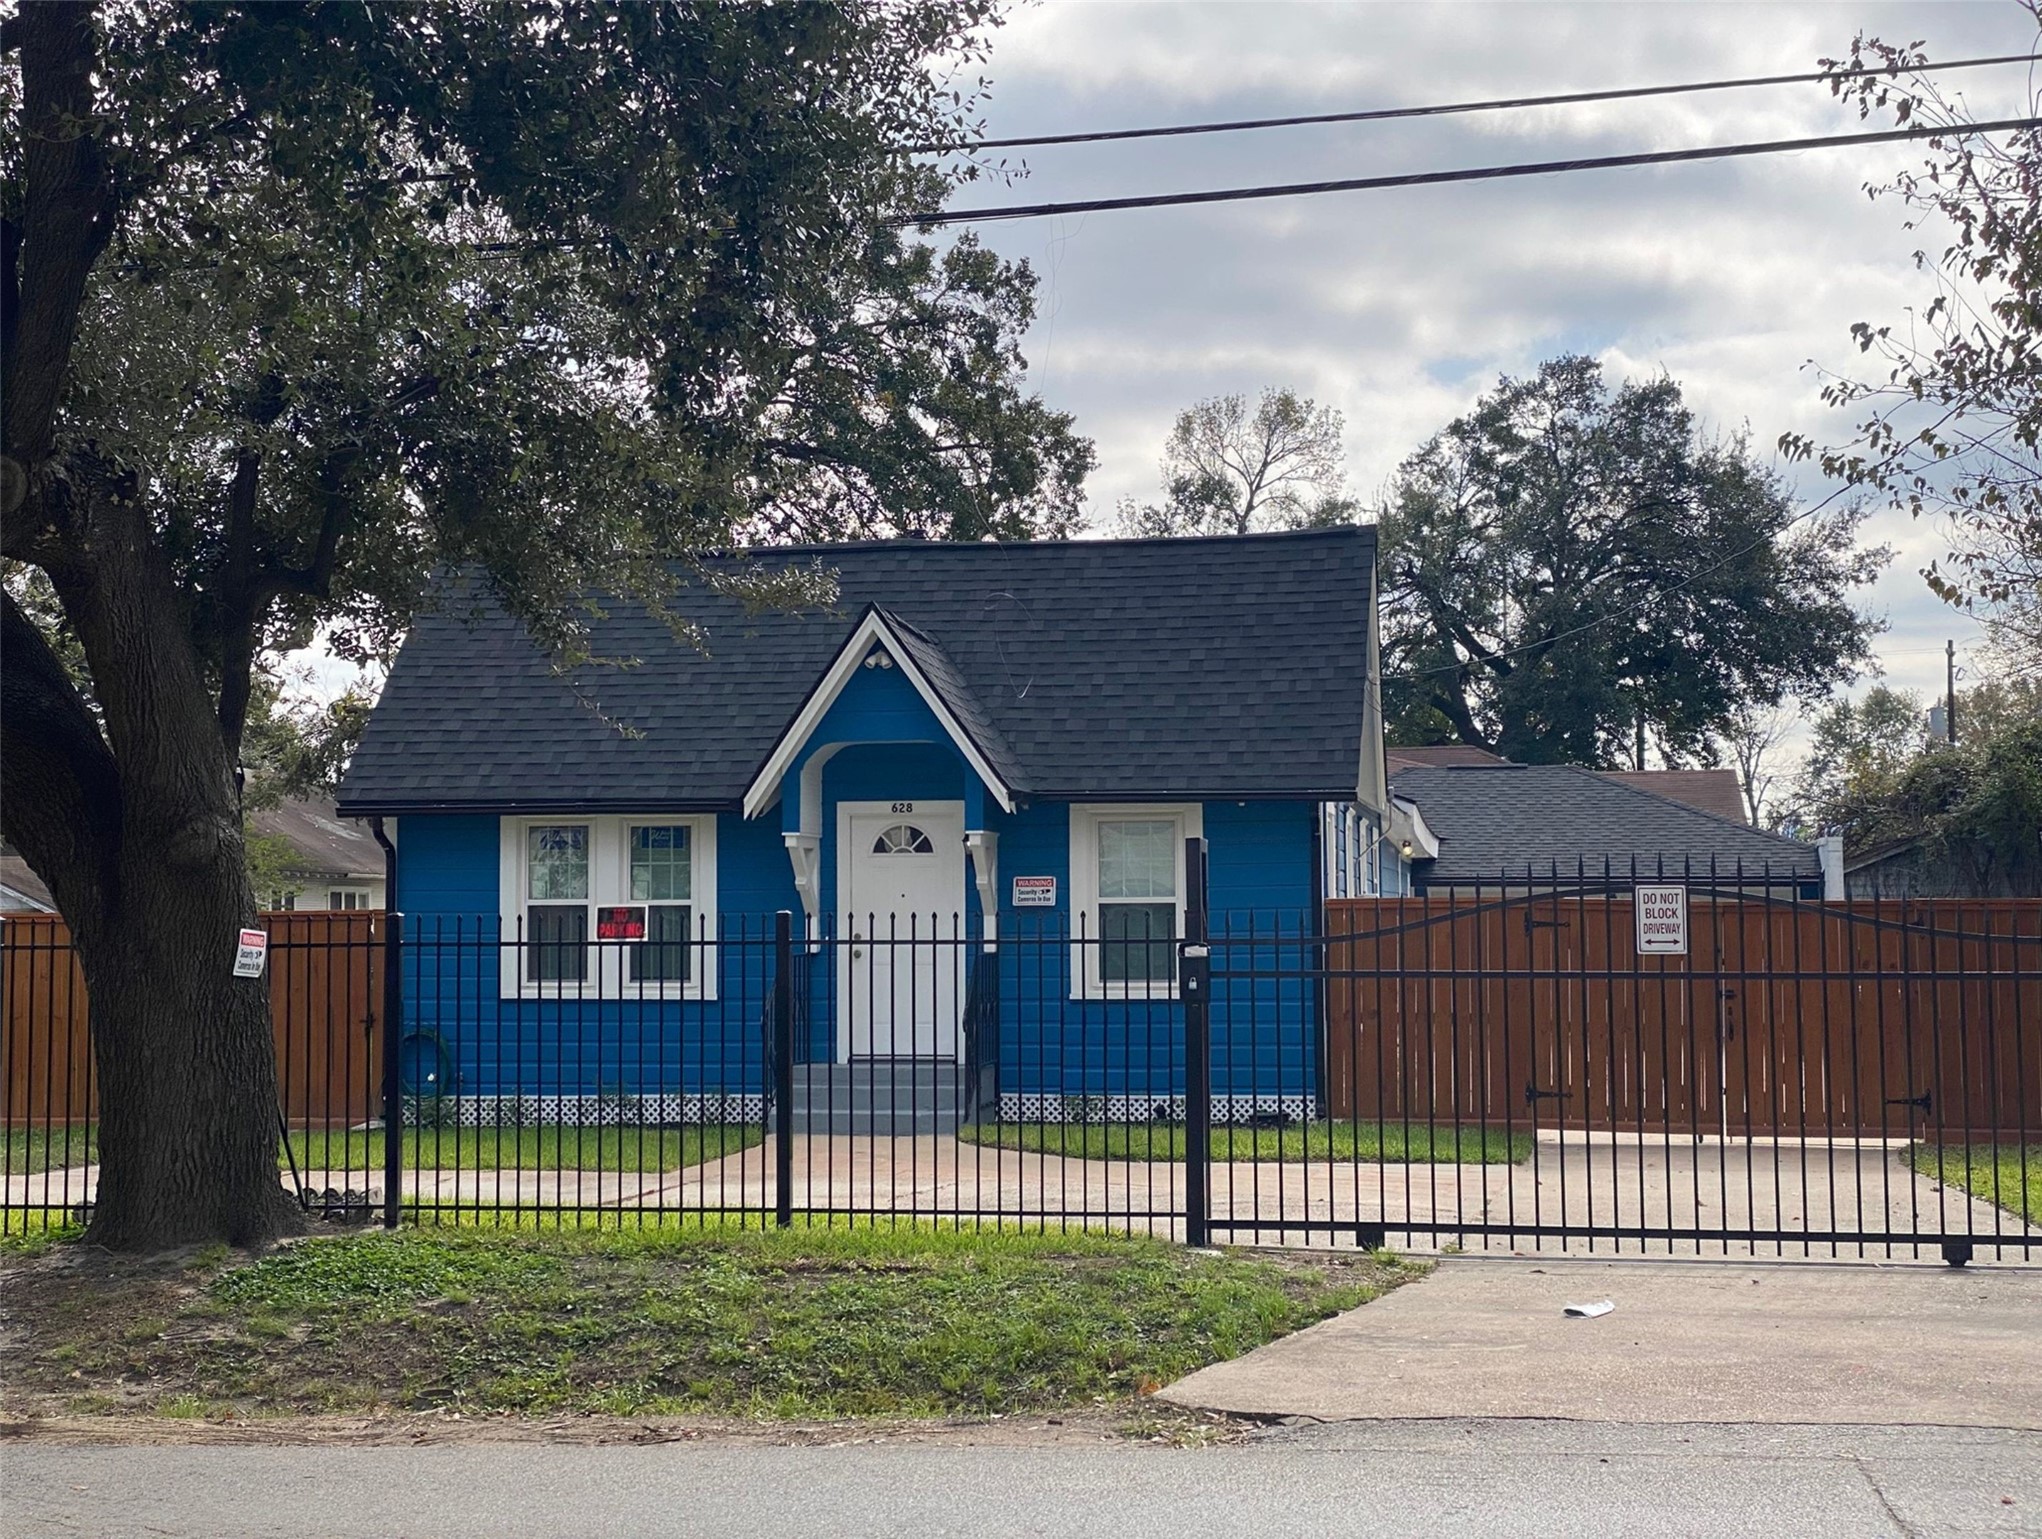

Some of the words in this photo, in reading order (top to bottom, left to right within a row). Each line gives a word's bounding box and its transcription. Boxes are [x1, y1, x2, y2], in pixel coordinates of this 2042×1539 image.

[891, 802, 913, 813] 628
[1643, 893, 1657, 904] DO
[1660, 893, 1680, 904] NOT
[613, 908, 629, 922] NO
[1645, 907, 1679, 919] BLOCK
[599, 922, 643, 938] PARKING
[1643, 923, 1681, 934] DRIVEWAY
[242, 933, 264, 946] WARNING
